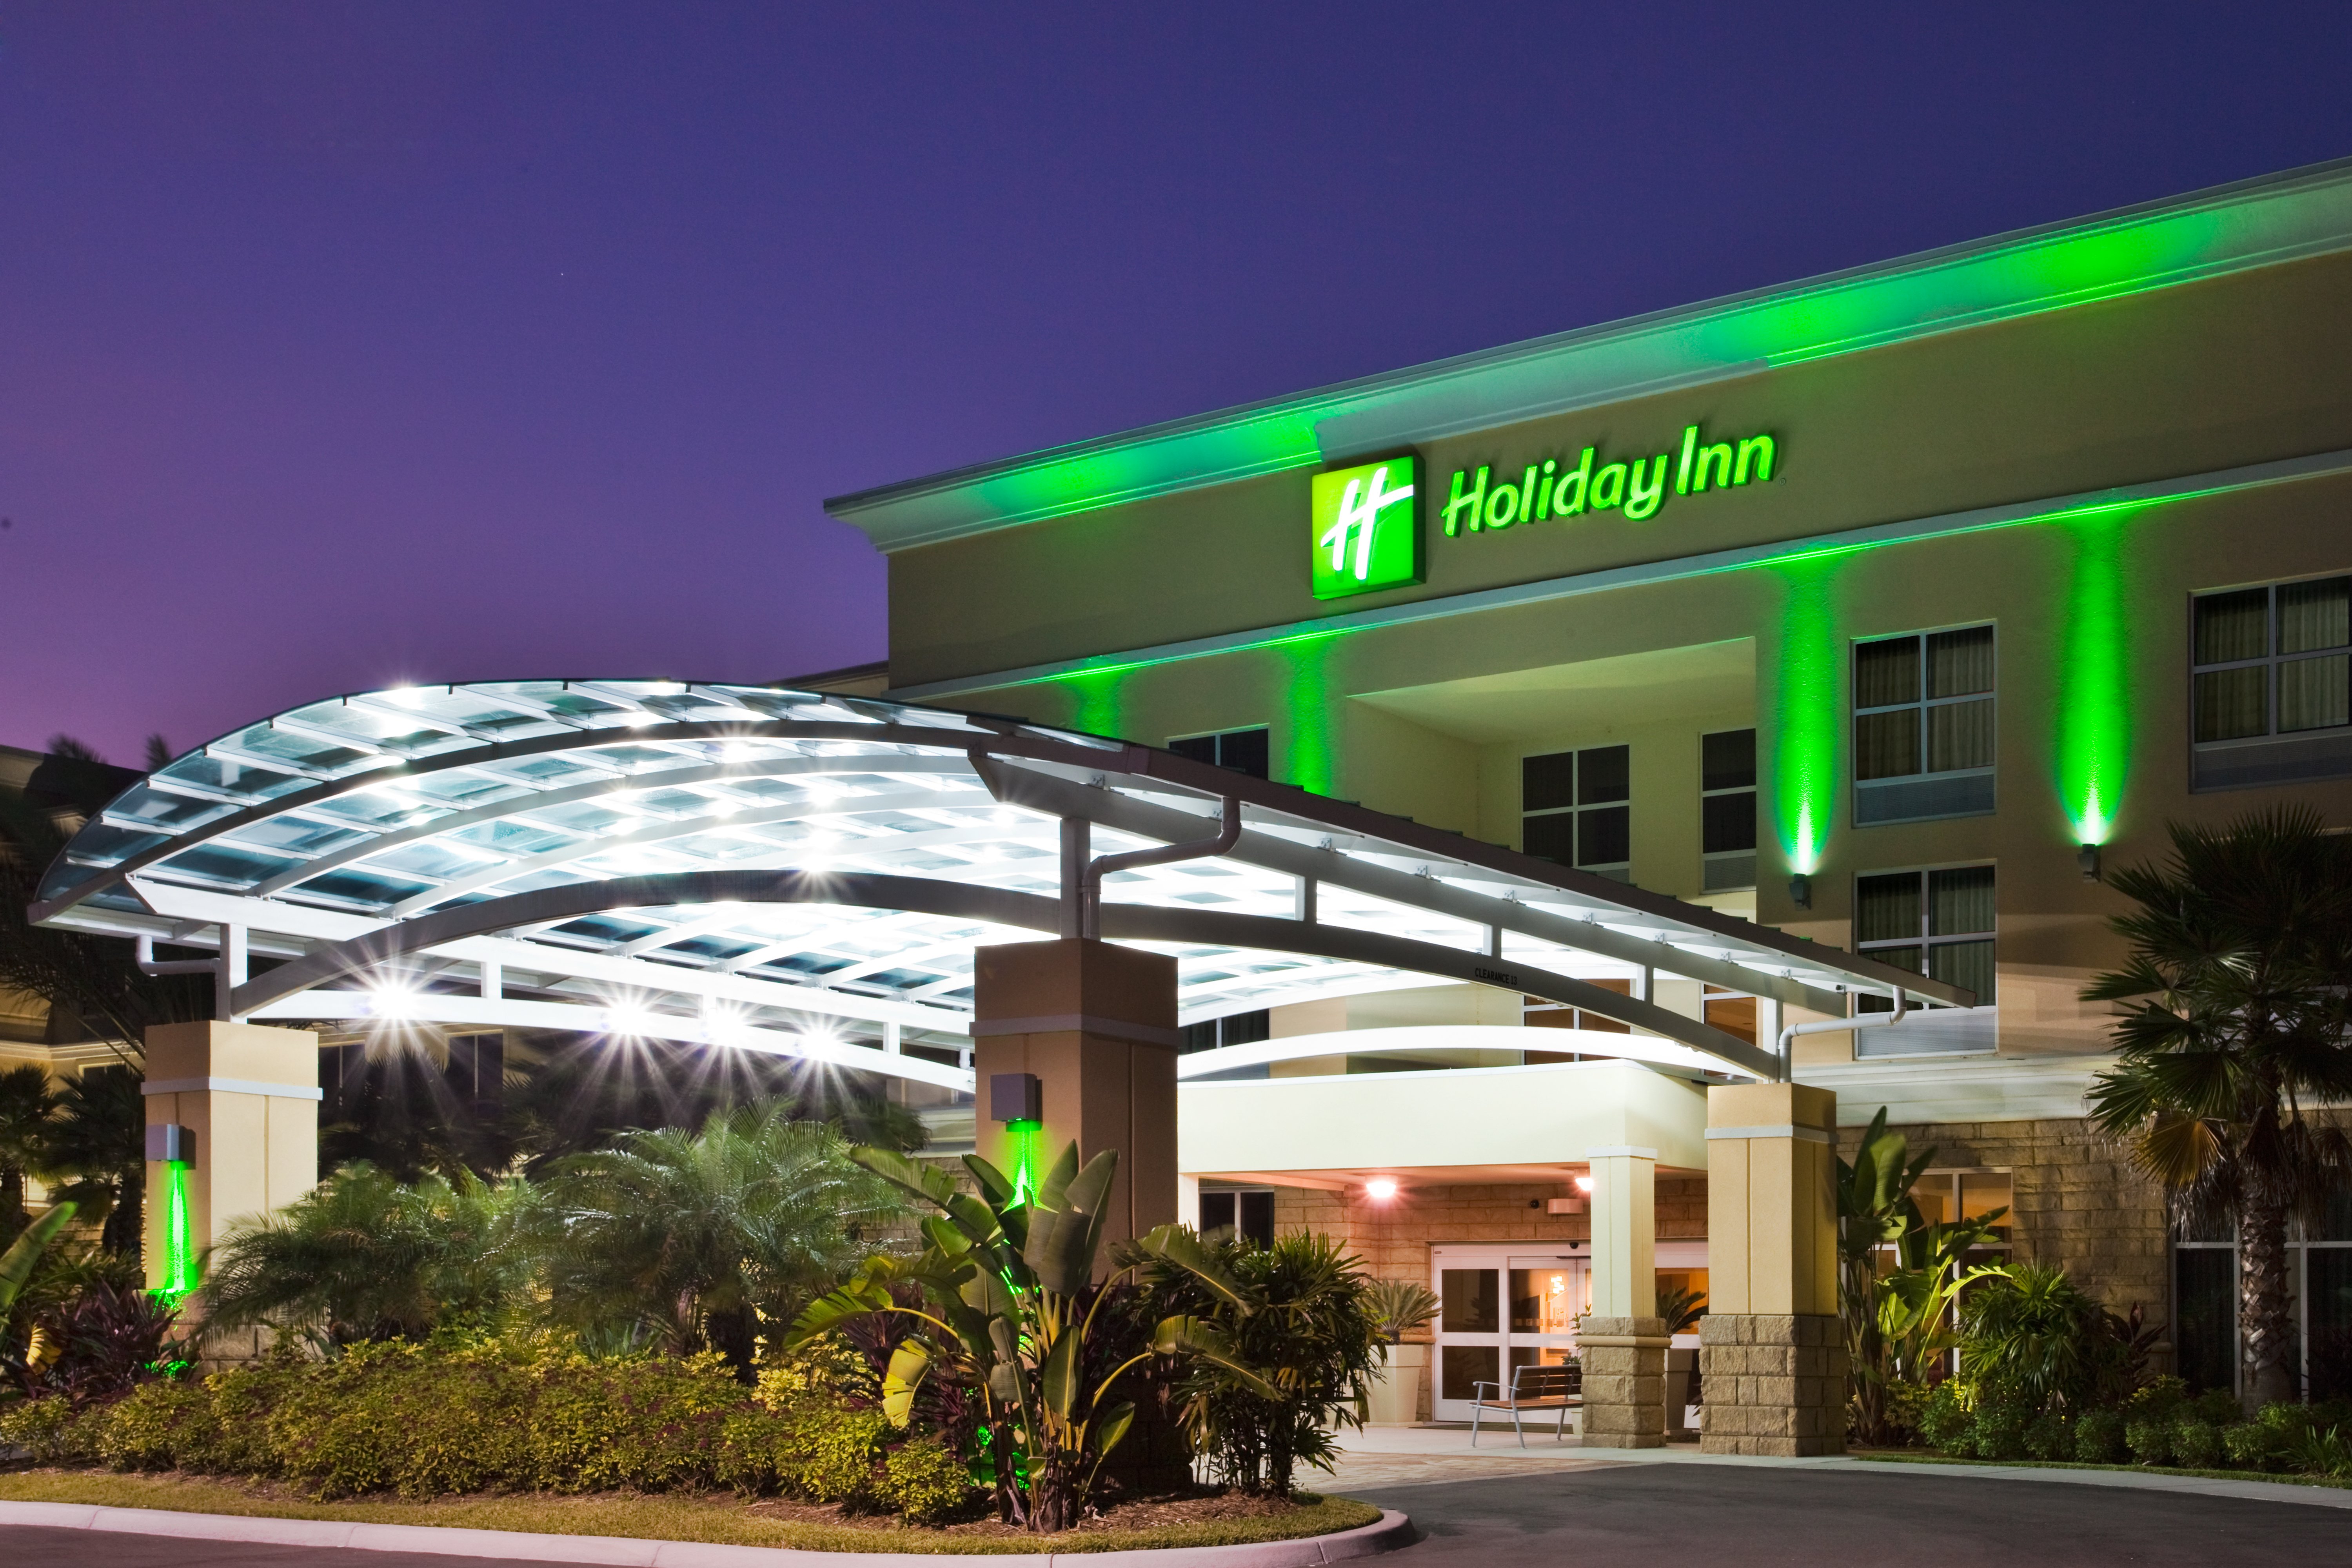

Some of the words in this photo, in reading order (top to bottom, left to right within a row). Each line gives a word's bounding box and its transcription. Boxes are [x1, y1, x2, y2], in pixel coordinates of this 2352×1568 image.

[1320, 466, 1413, 581] H
[1440, 446, 1668, 536] Holiday
[1676, 426, 1774, 495] Inn
[1475, 967, 1509, 984] CLEARANCE
[1511, 975, 1517, 985] 13
